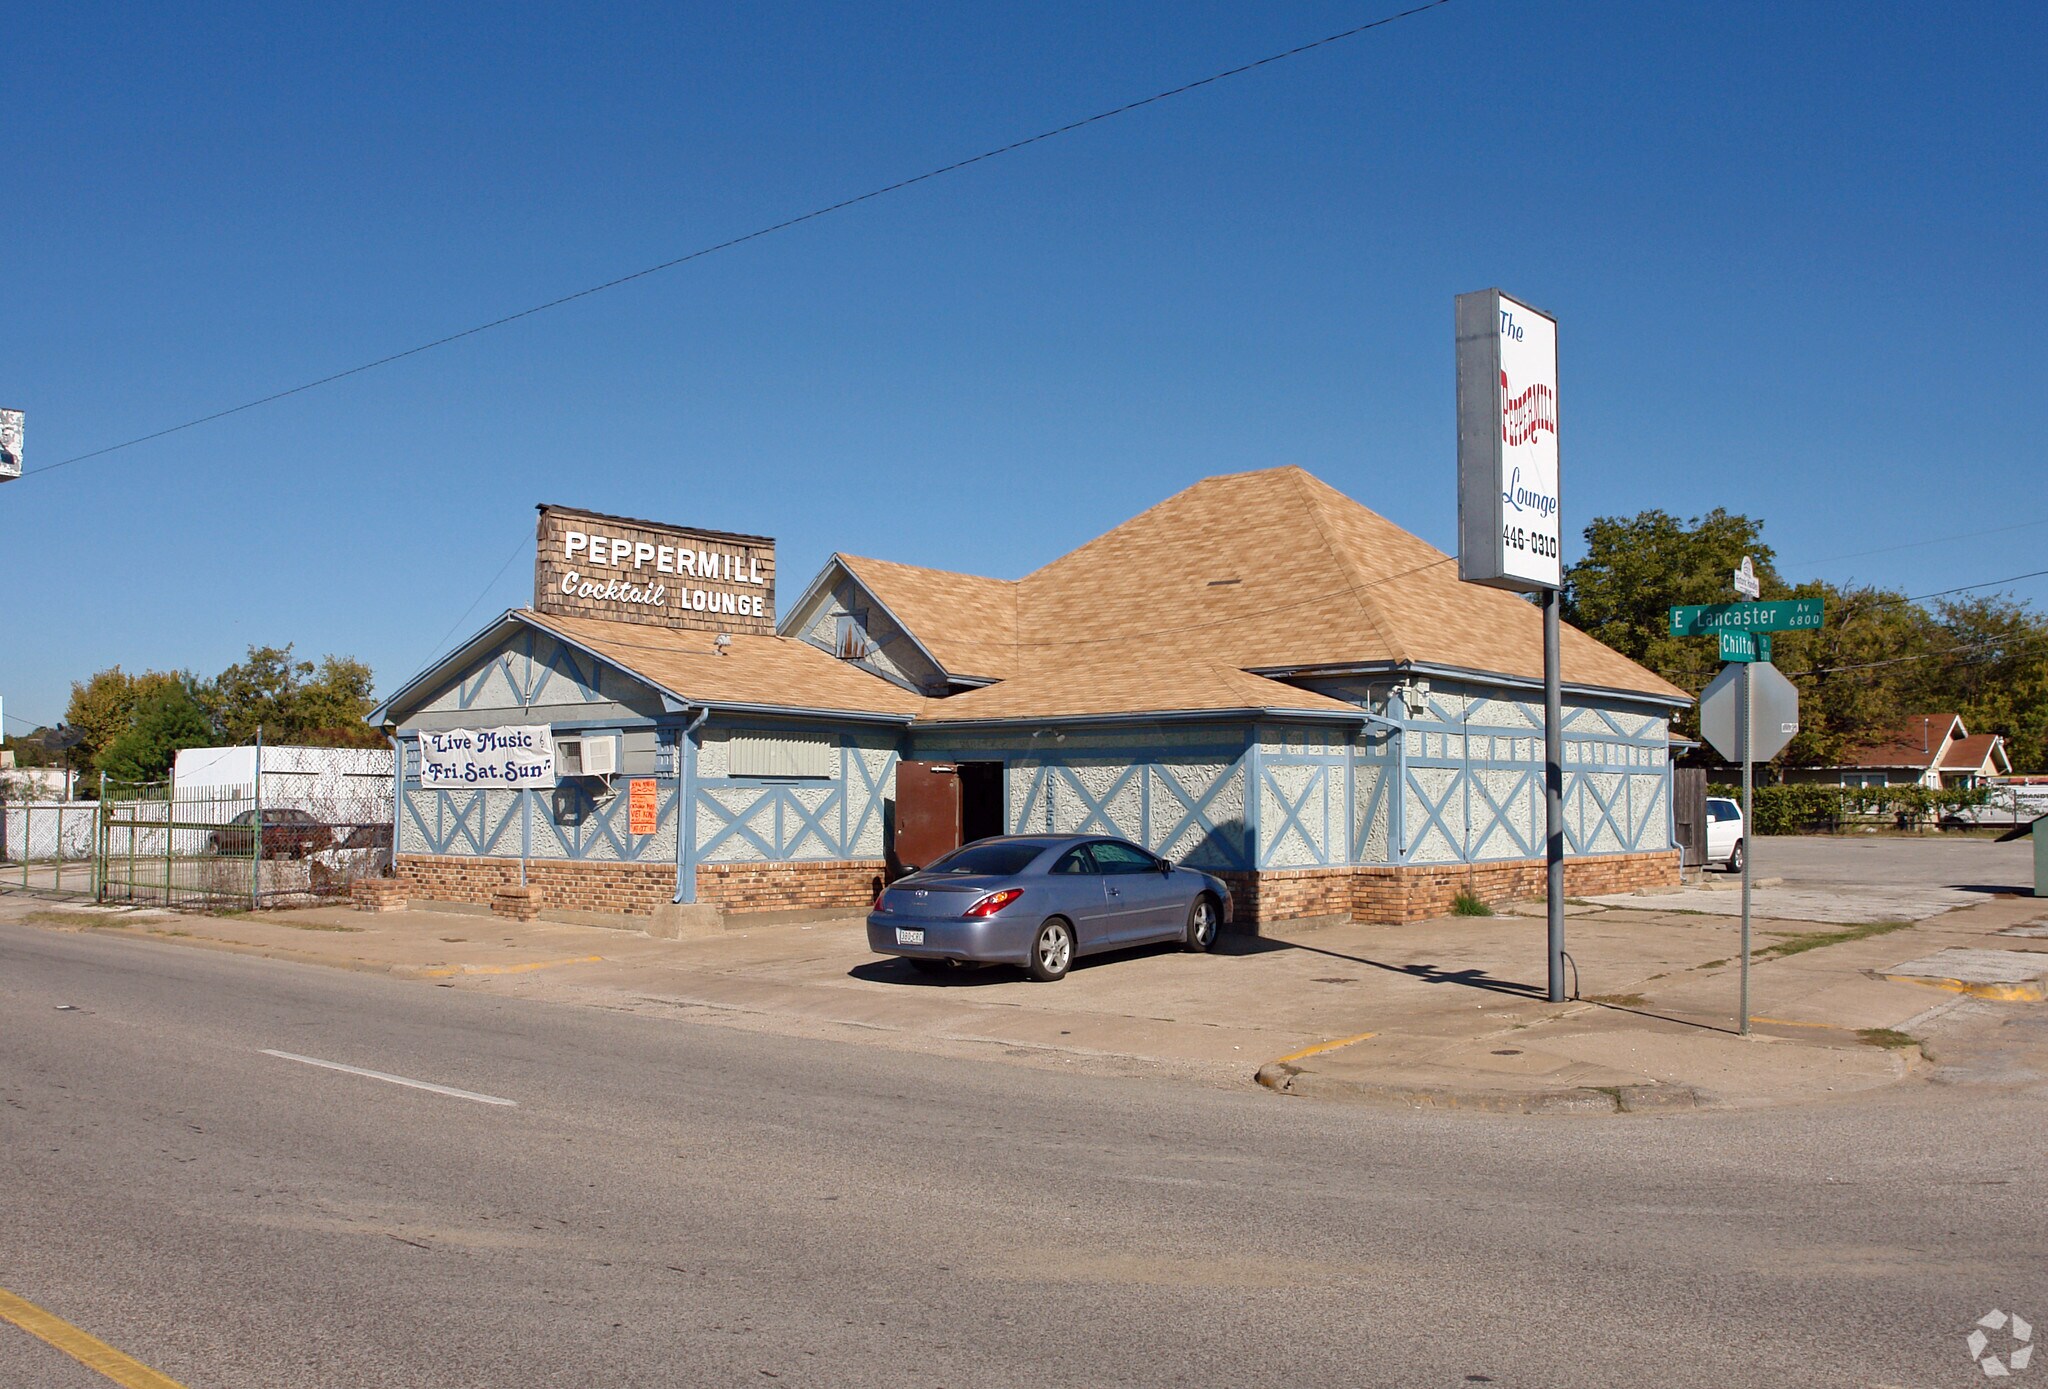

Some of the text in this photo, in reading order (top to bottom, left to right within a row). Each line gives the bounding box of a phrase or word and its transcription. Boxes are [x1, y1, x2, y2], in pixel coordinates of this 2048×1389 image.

[1500, 310, 1523, 342] The
[1502, 467, 1556, 518] Lounge
[565, 531, 764, 585] PEPPERMILL
[1503, 524, 1557, 559] 446-0310
[561, 570, 763, 618] Cocktail LOUNGE
[1675, 603, 1810, 628] E Lancaster Av
[1789, 615, 1820, 626] 6800
[432, 730, 533, 753] Live Music
